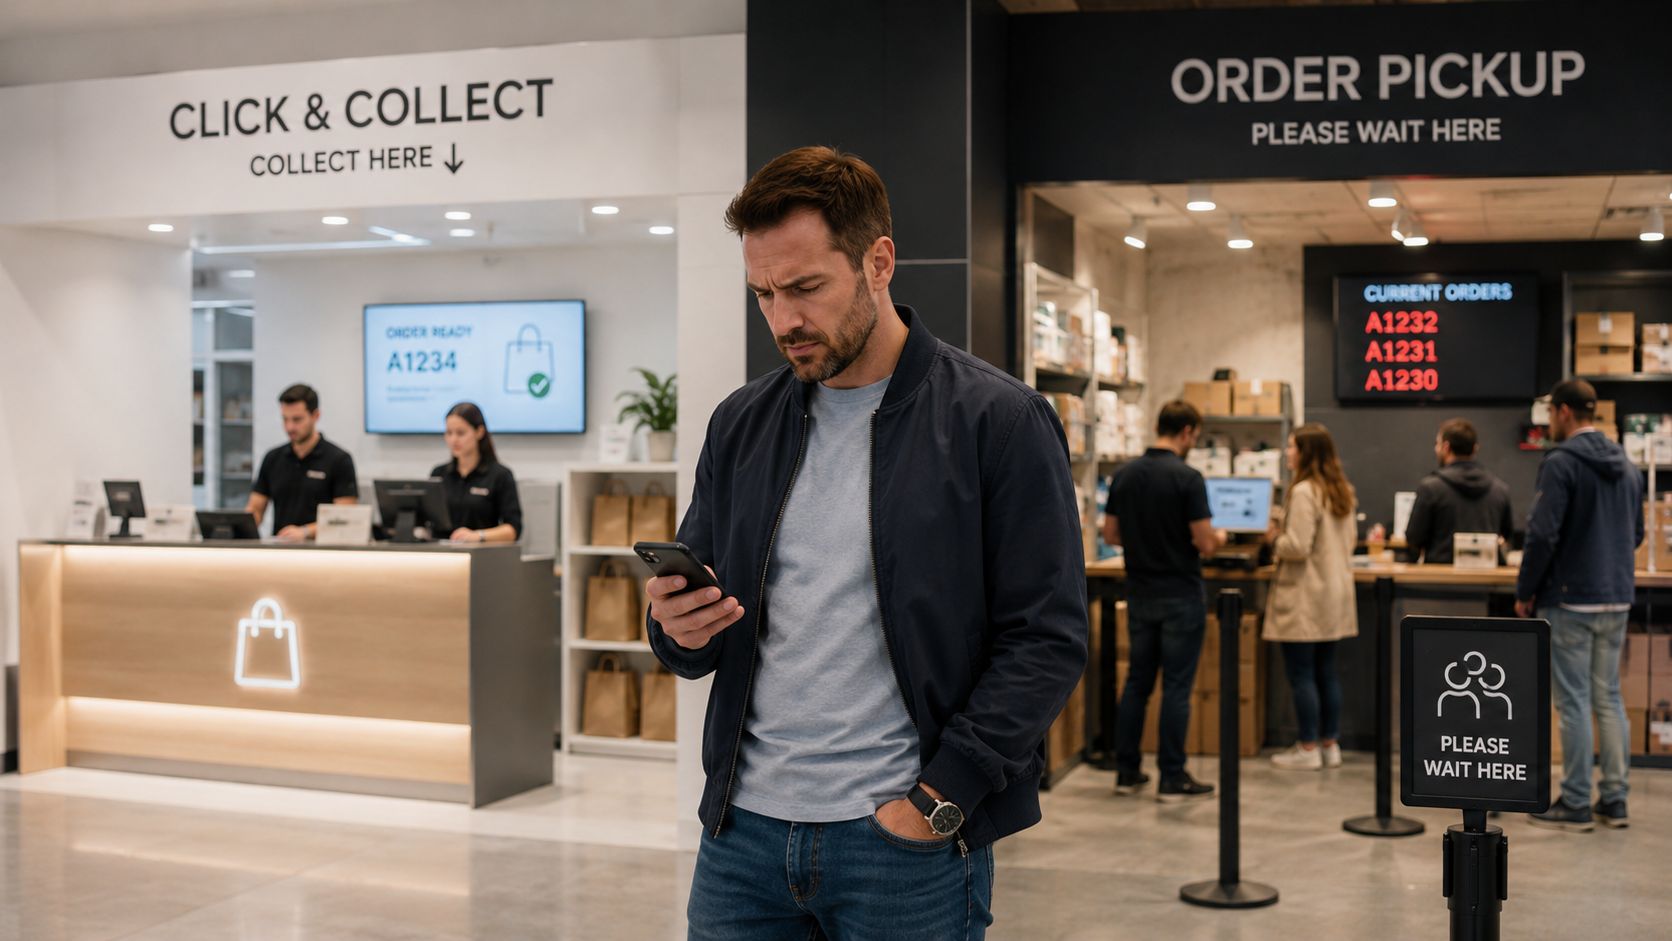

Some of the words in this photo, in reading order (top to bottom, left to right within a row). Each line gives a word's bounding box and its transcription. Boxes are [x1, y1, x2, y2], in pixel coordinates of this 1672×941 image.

[1170, 55, 1362, 104] ORDER
[1378, 50, 1586, 100] PICKUP
[169, 95, 290, 140] CLICK
[303, 93, 331, 131] &
[345, 77, 554, 128] COLLECT
[1251, 120, 1350, 146] PLEASE
[1356, 119, 1425, 143] WAIT
[1432, 117, 1502, 142] HERE
[250, 149, 361, 177] COLLECT
[369, 145, 433, 170] HERE
[1363, 283, 1442, 303] CURRENT
[1444, 283, 1513, 302] ORDERS
[386, 326, 428, 339] ORDER
[432, 325, 473, 338] READY
[1365, 310, 1439, 334] A1232
[386, 351, 458, 373] A1234
[1365, 339, 1438, 363] A1231
[1365, 368, 1439, 392] A1230
[1441, 735, 1510, 755] PLEASE
[1423, 759, 1473, 778] WAIT
[1477, 761, 1527, 781] HERE
